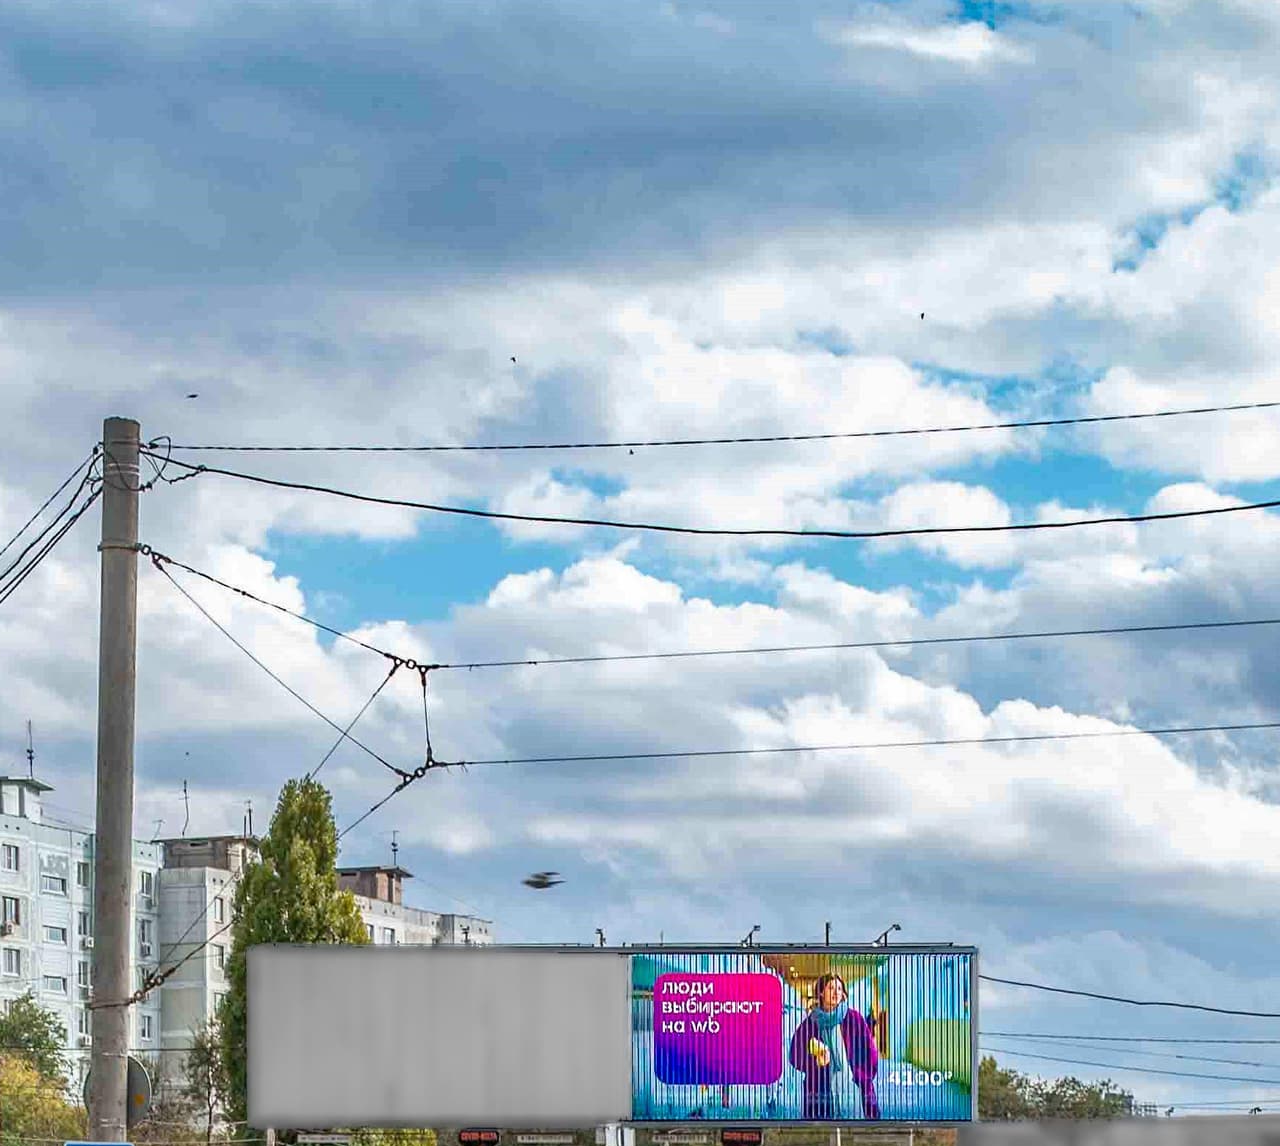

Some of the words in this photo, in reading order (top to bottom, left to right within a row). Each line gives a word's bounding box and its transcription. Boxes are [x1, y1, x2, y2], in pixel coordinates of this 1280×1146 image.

[662, 981, 715, 997] люди
[662, 997, 763, 1018] выбирают
[662, 1020, 686, 1034] на
[690, 1015, 721, 1034] wb
